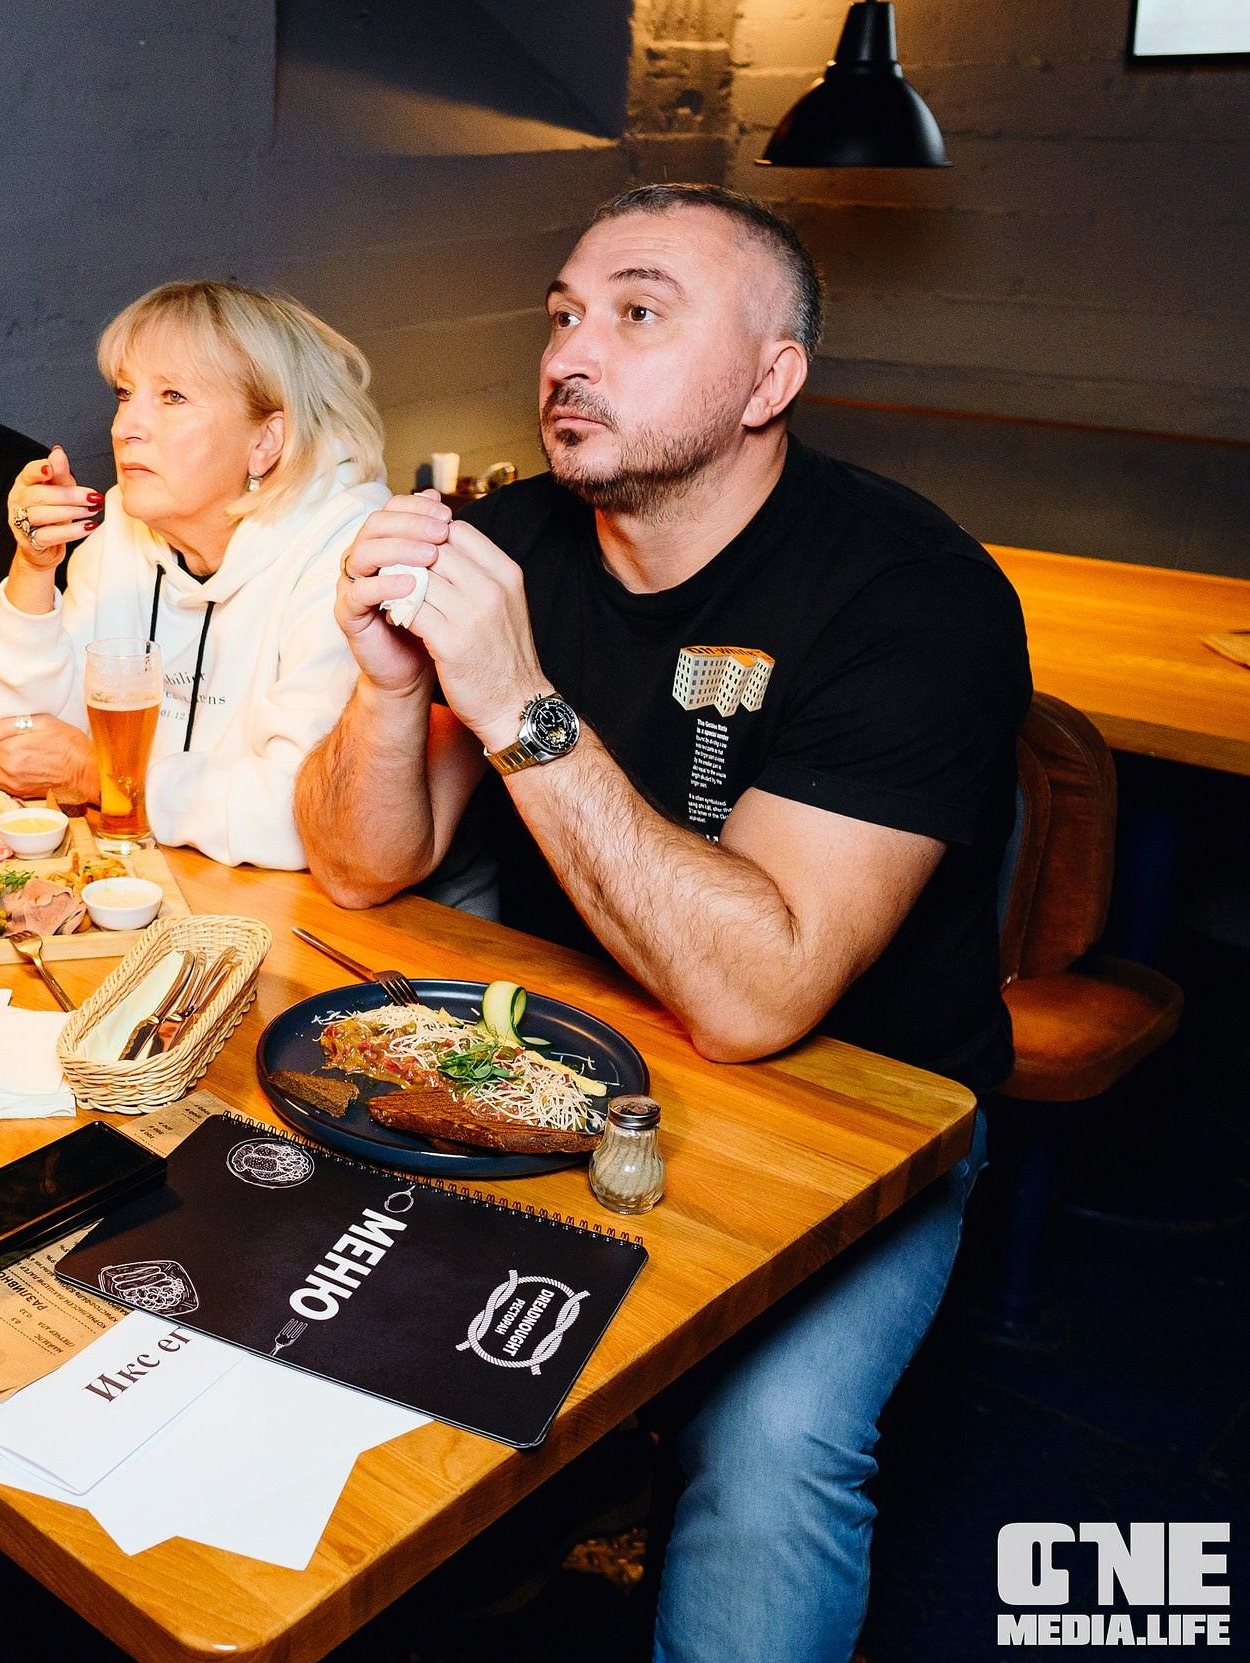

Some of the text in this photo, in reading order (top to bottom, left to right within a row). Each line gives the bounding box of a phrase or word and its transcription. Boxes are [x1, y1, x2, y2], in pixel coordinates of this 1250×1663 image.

[289, 1208, 407, 1320] МЕНЮ
[494, 1298, 526, 1335] РЕСТОРАН
[502, 1288, 555, 1357] DREADNOUGHT
[81, 1353, 161, 1404] Икс
